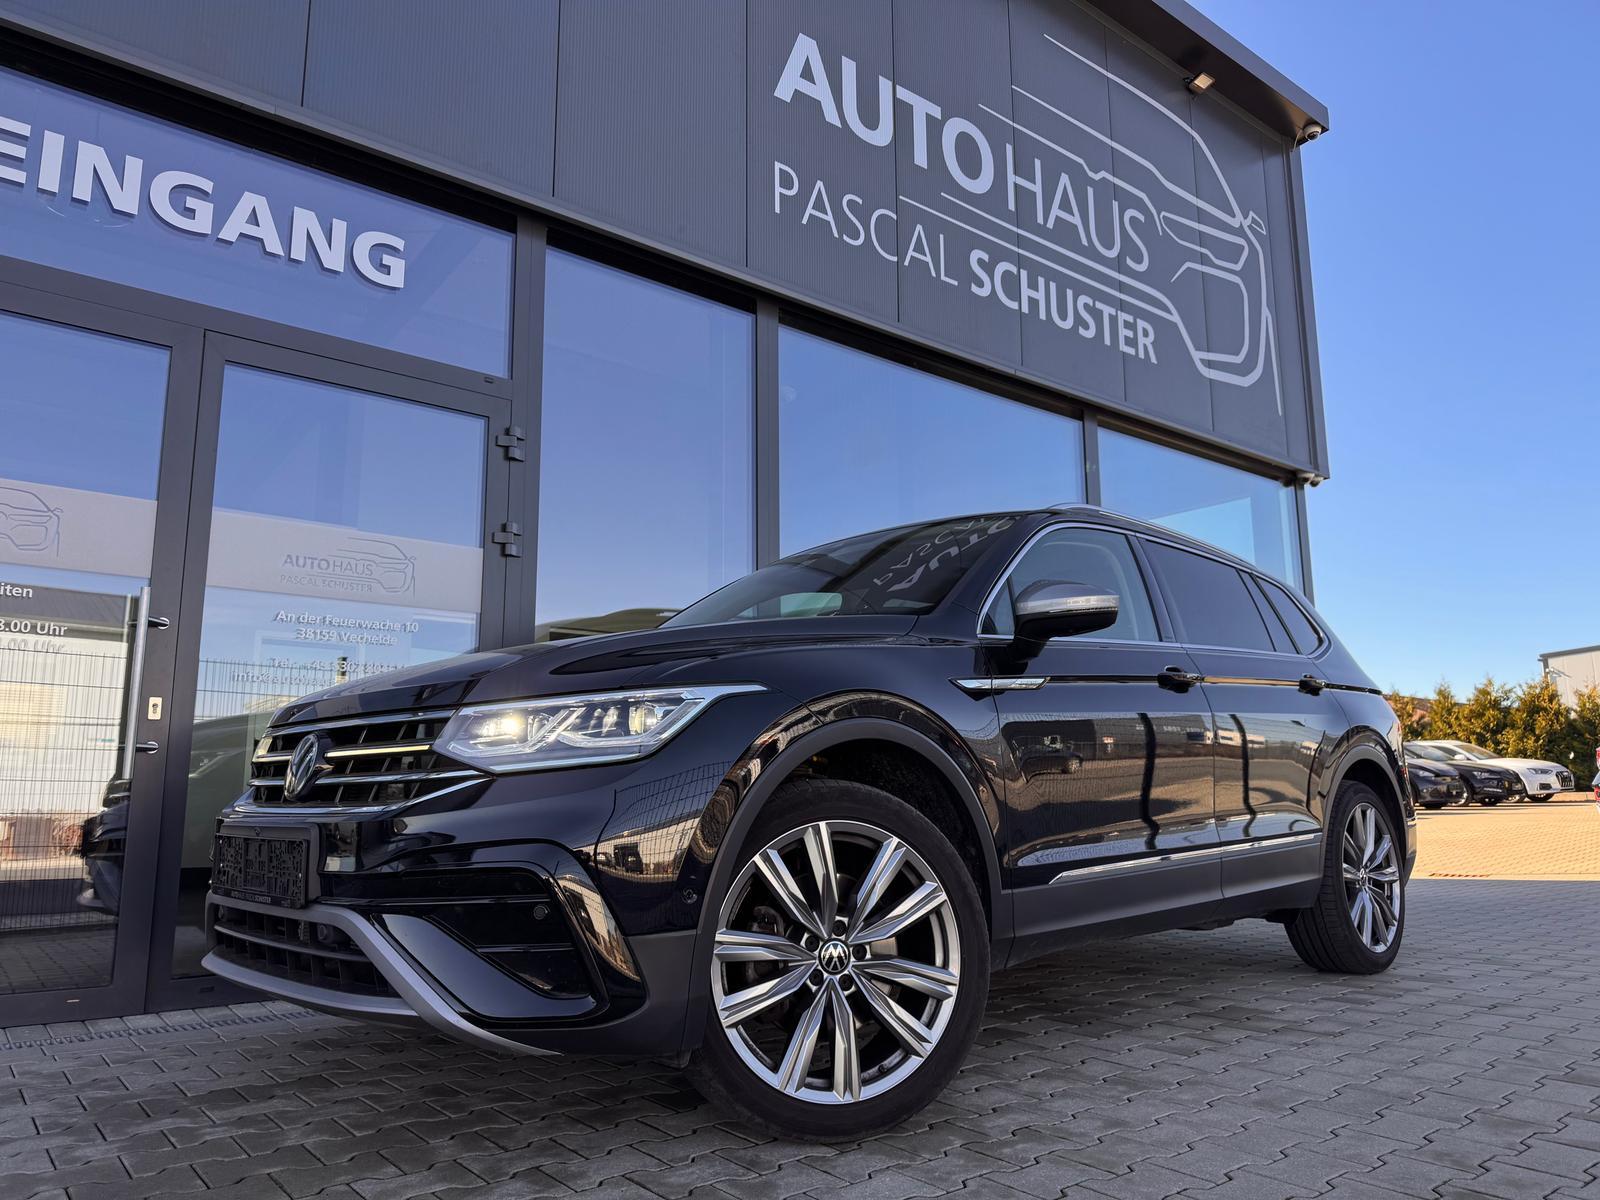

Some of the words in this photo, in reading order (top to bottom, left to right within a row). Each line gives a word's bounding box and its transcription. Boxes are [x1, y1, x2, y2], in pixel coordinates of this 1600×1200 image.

[0, 115, 406, 289] EINGANG
[773, 33, 1150, 272] AUTOHAUS
[774, 161, 958, 286] PASCAL
[970, 249, 1157, 364] SCHUSTER
[36, 621, 68, 636] Uhr
[275, 609, 296, 623] An
[299, 611, 321, 625] der
[325, 614, 401, 631] Feuerwache
[404, 621, 419, 633] 10
[299, 626, 338, 641] 38159
